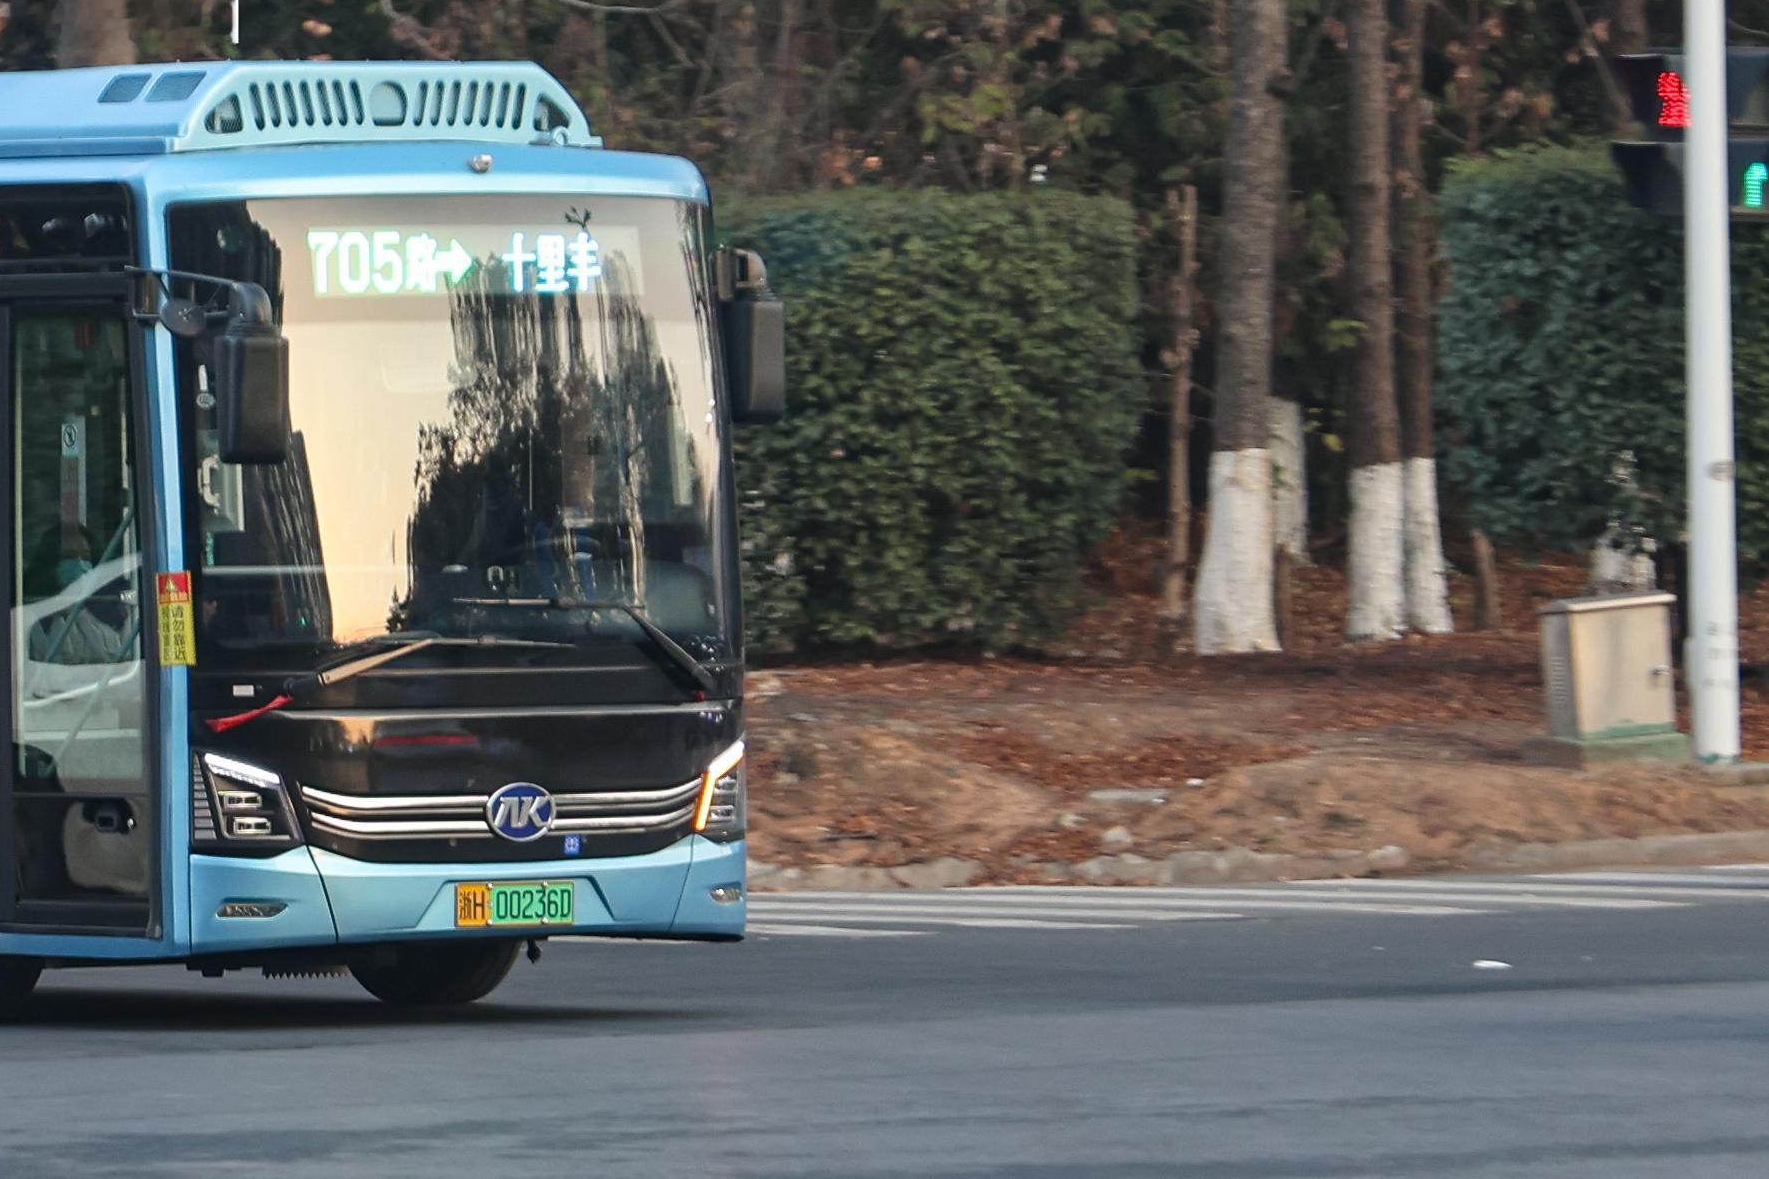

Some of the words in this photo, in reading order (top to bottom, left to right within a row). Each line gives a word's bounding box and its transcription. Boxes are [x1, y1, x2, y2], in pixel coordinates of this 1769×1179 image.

[307, 231, 438, 293] 705路
[502, 232, 602, 293] 十里丰
